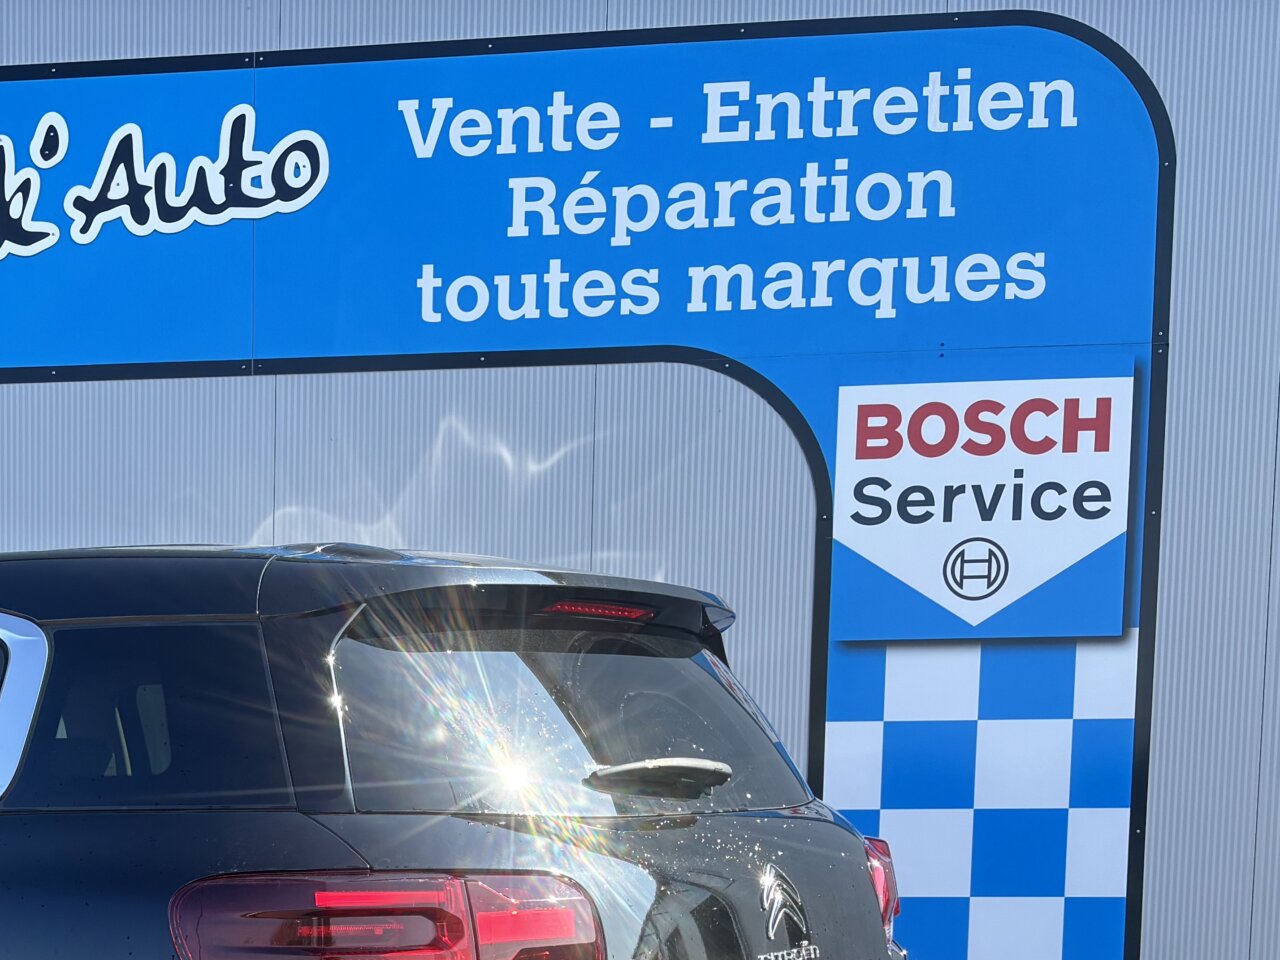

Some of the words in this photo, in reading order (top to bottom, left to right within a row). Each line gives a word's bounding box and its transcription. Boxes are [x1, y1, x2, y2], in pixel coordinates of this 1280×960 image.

[397, 91, 621, 159] Vente
[650, 116, 673, 128] -
[701, 67, 1078, 144] Entretien
[506, 158, 956, 247] Réparation
[416, 258, 660, 323] toutes
[687, 248, 1046, 319] marques
[855, 397, 1111, 460] BOSCH
[849, 468, 1112, 526] Service
